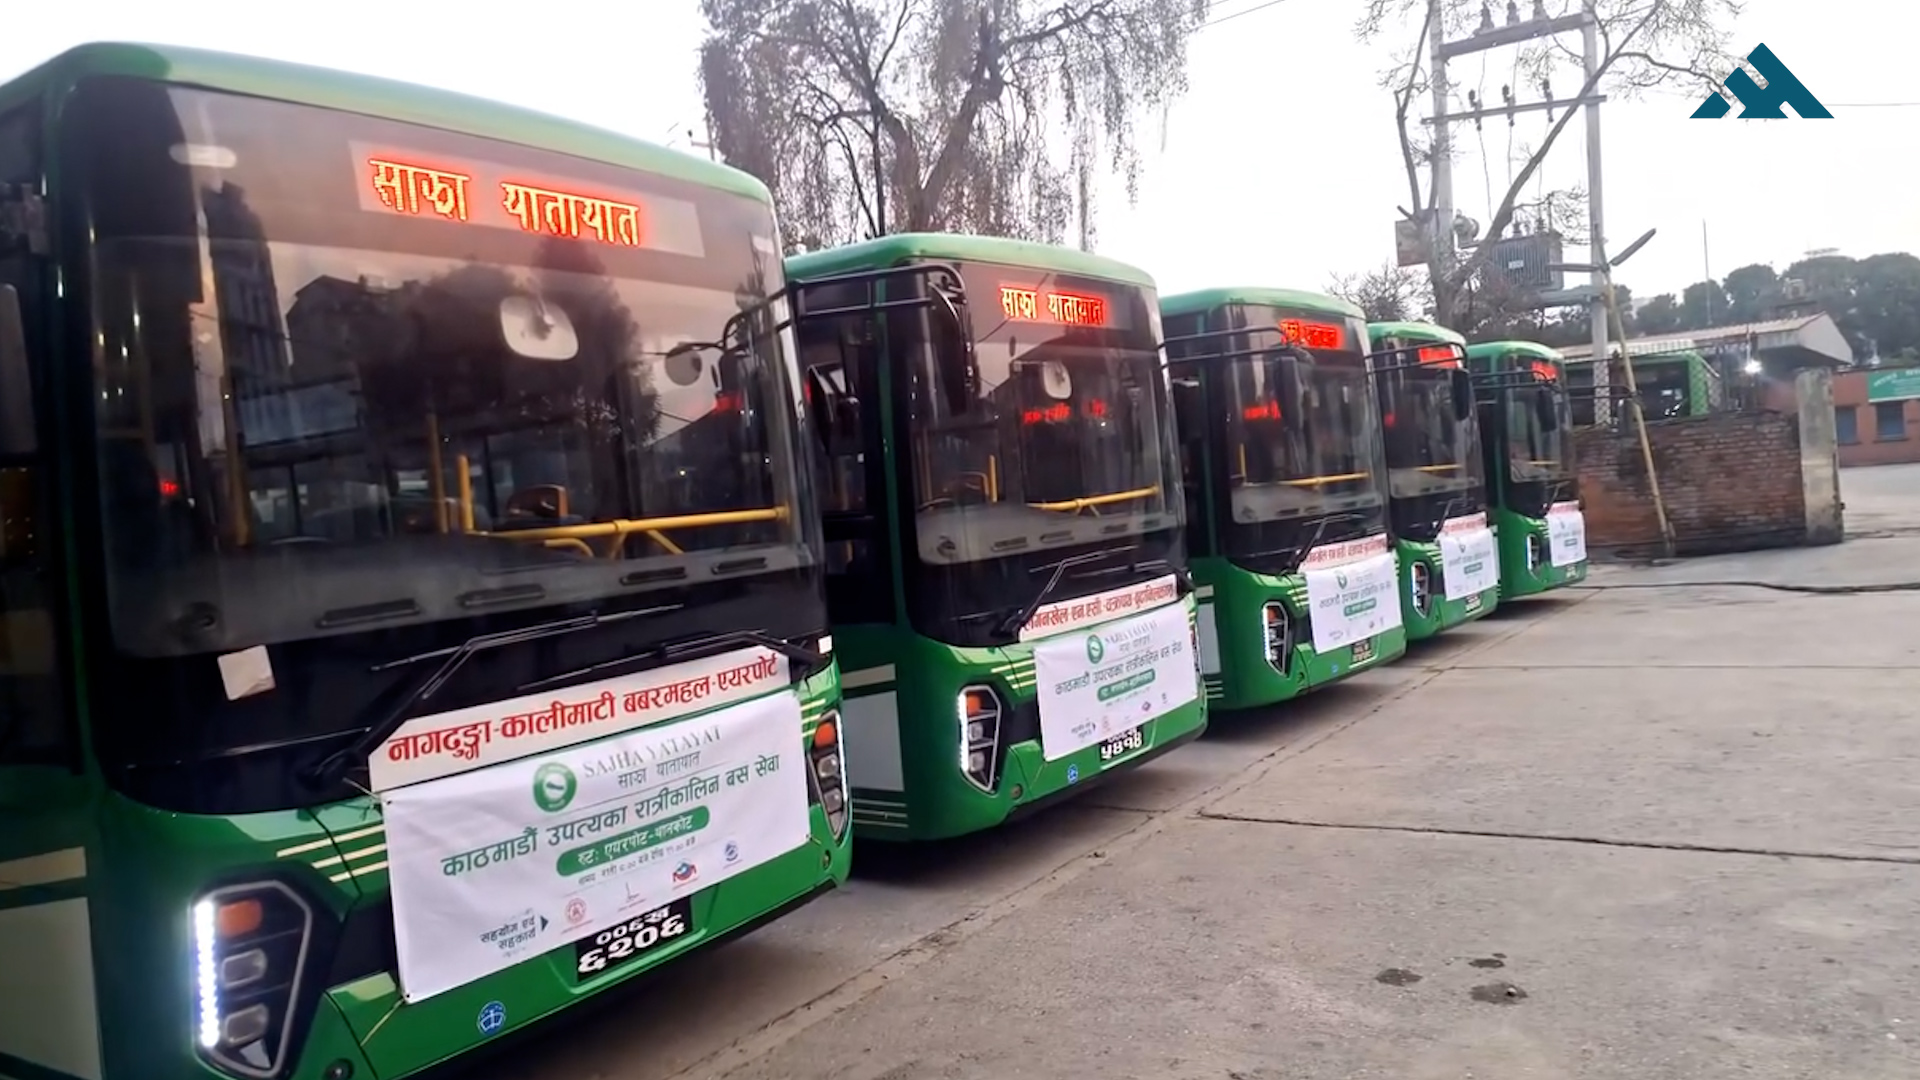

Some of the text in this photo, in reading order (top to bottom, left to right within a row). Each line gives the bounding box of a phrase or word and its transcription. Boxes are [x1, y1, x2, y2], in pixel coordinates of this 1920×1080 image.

[368, 159, 640, 246] साझा यातायात
[1001, 288, 1037, 319] साझा
[582, 725, 721, 779] SAJHA YATAYAT
[545, 806, 627, 846] उपत्यका
[726, 765, 749, 787] बस
[755, 754, 780, 777] सेवा
[578, 913, 686, 973] ६२०६
